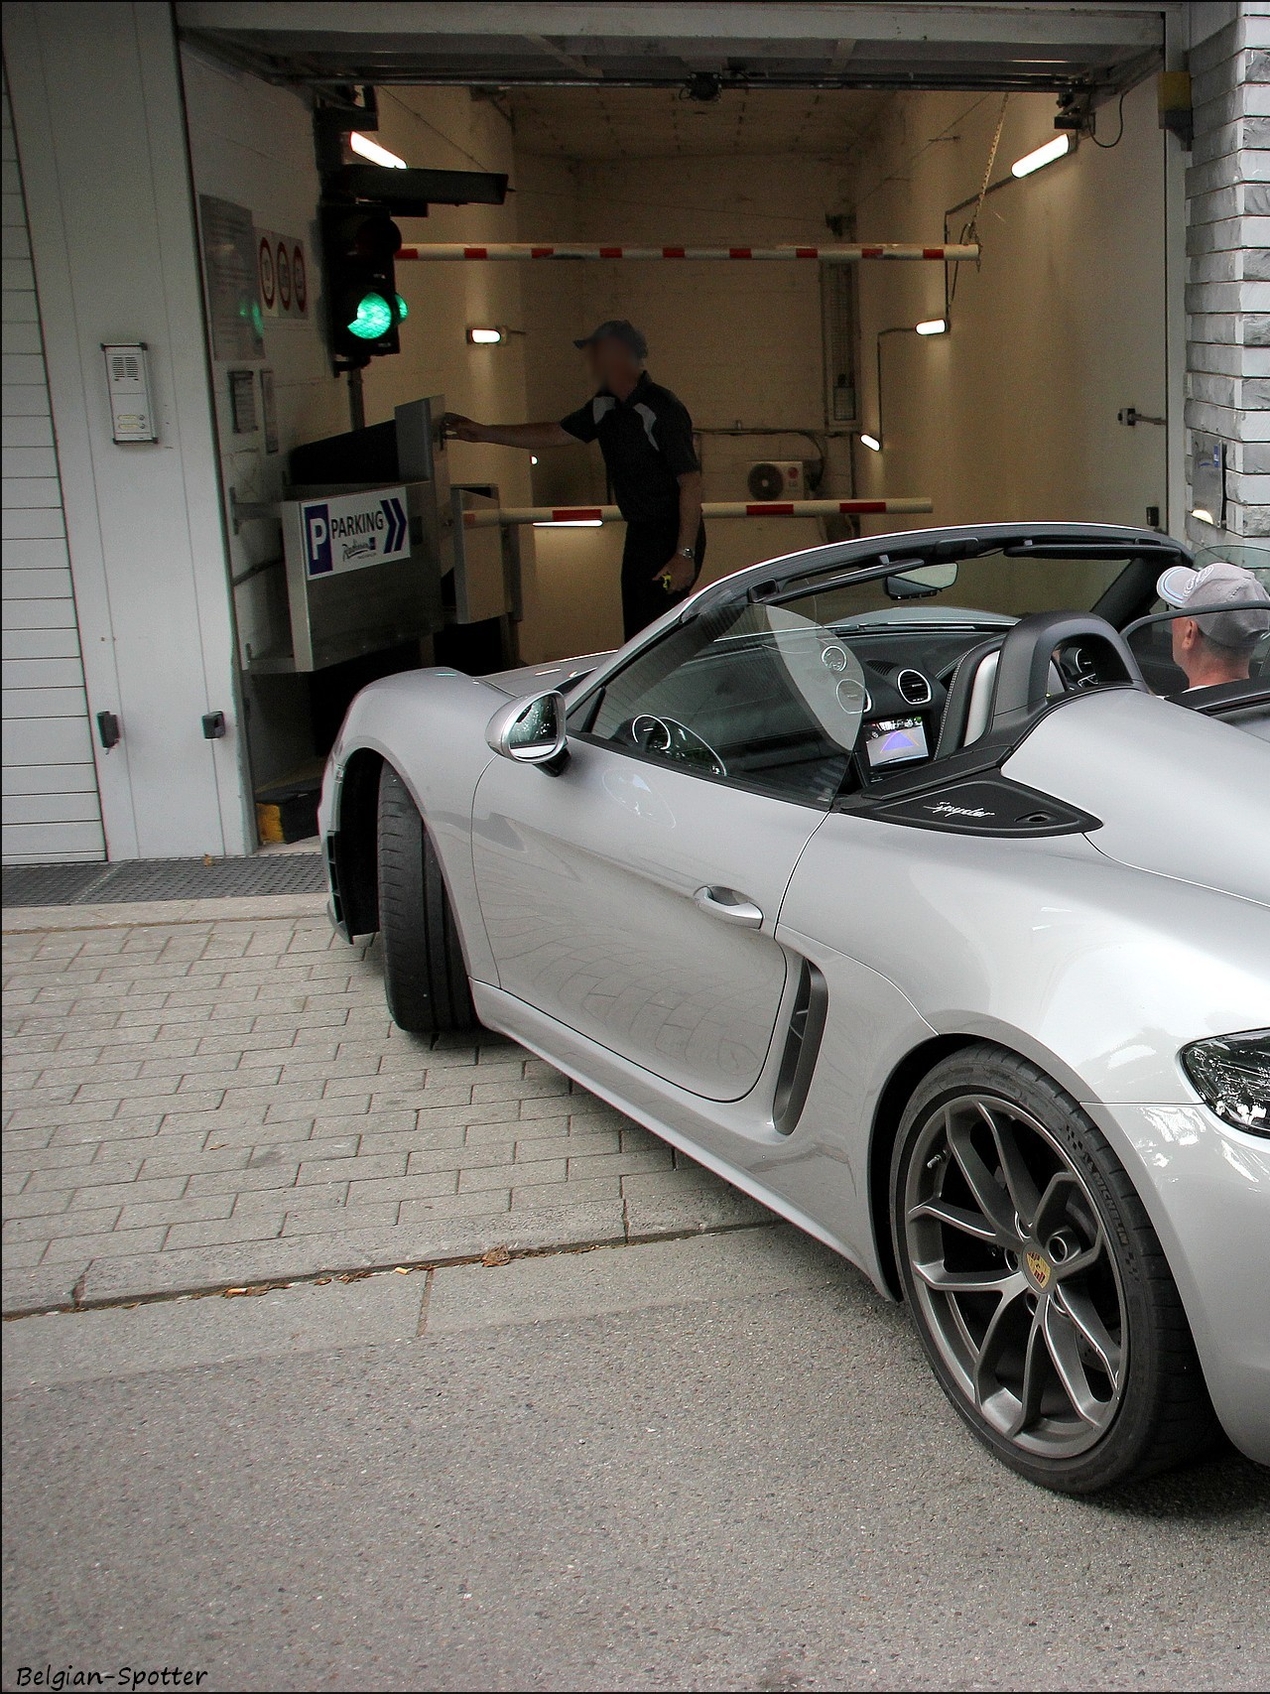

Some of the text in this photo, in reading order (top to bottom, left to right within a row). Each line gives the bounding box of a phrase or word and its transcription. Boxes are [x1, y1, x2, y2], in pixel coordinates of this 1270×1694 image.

[310, 511, 384, 560] P PARKING
[923, 801, 996, 818] Spyder
[1092, 1171, 1130, 1245] MICHELIN
